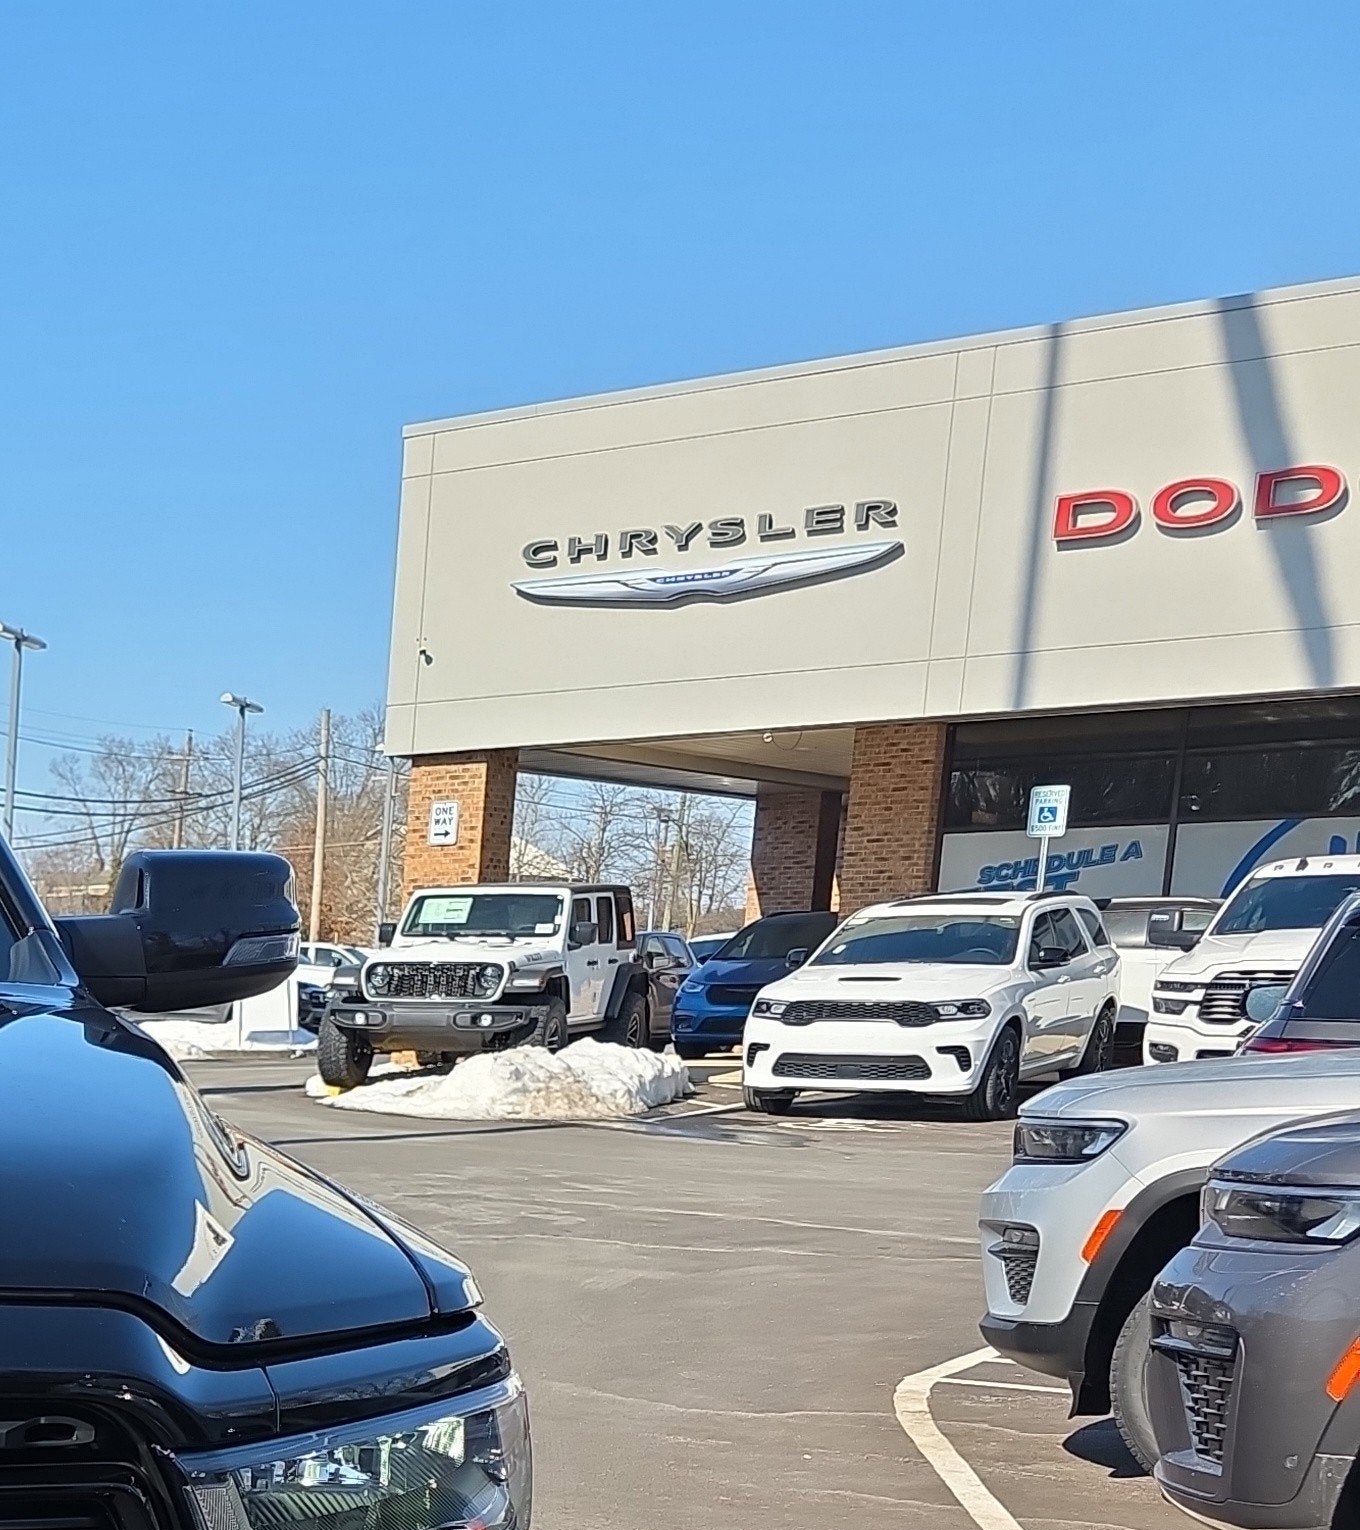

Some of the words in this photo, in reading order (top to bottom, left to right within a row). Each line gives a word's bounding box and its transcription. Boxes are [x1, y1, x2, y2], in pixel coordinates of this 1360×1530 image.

[522, 499, 899, 568] CHRYSLER
[435, 806, 454, 816] ONE
[434, 817, 454, 826] WAY
[1120, 840, 1143, 862] A
